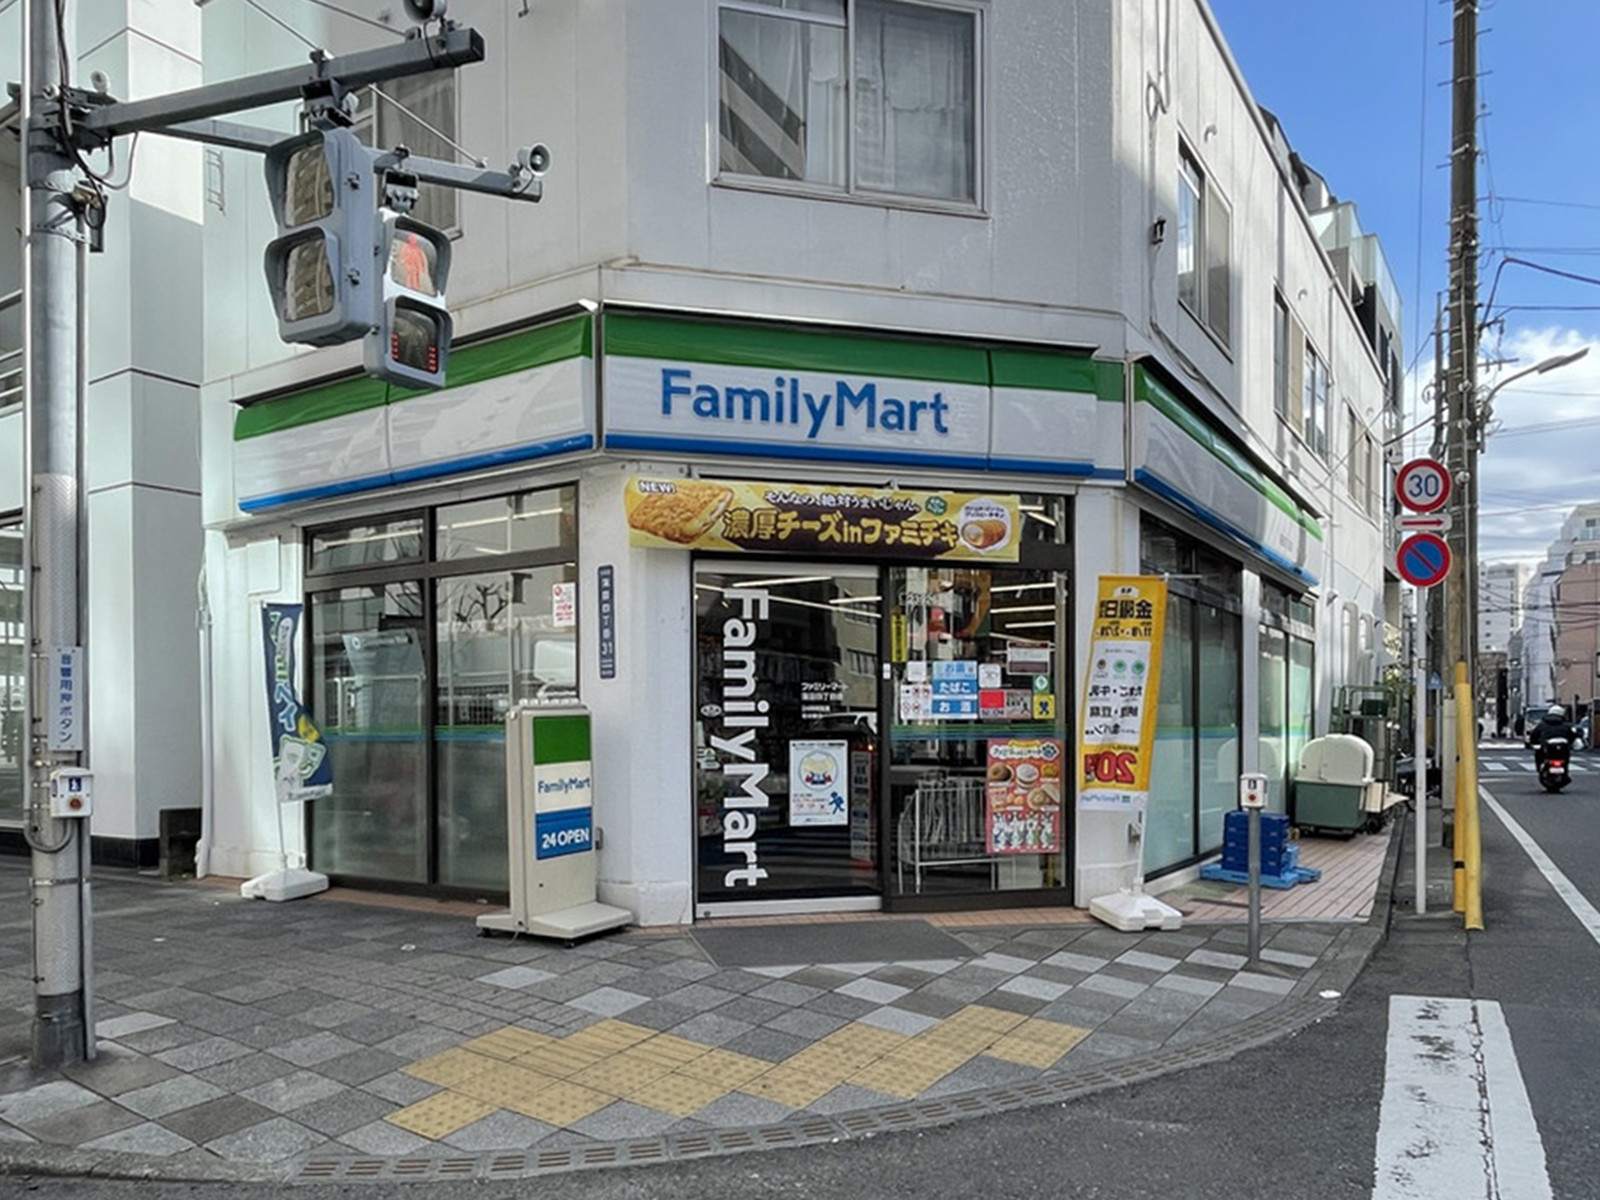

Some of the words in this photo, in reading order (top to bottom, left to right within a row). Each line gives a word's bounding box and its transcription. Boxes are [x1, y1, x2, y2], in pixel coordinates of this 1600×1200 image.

[661, 368, 949, 438] FamilyMart
[1408, 473, 1439, 498] 30
[722, 509, 958, 549] 濃厚チーズinファミチキ
[939, 681, 971, 694] たばこ
[710, 588, 769, 887] FamilyMart
[538, 777, 590, 794] FamilyMart
[542, 832, 557, 849] 24
[558, 828, 589, 846] OPEN
